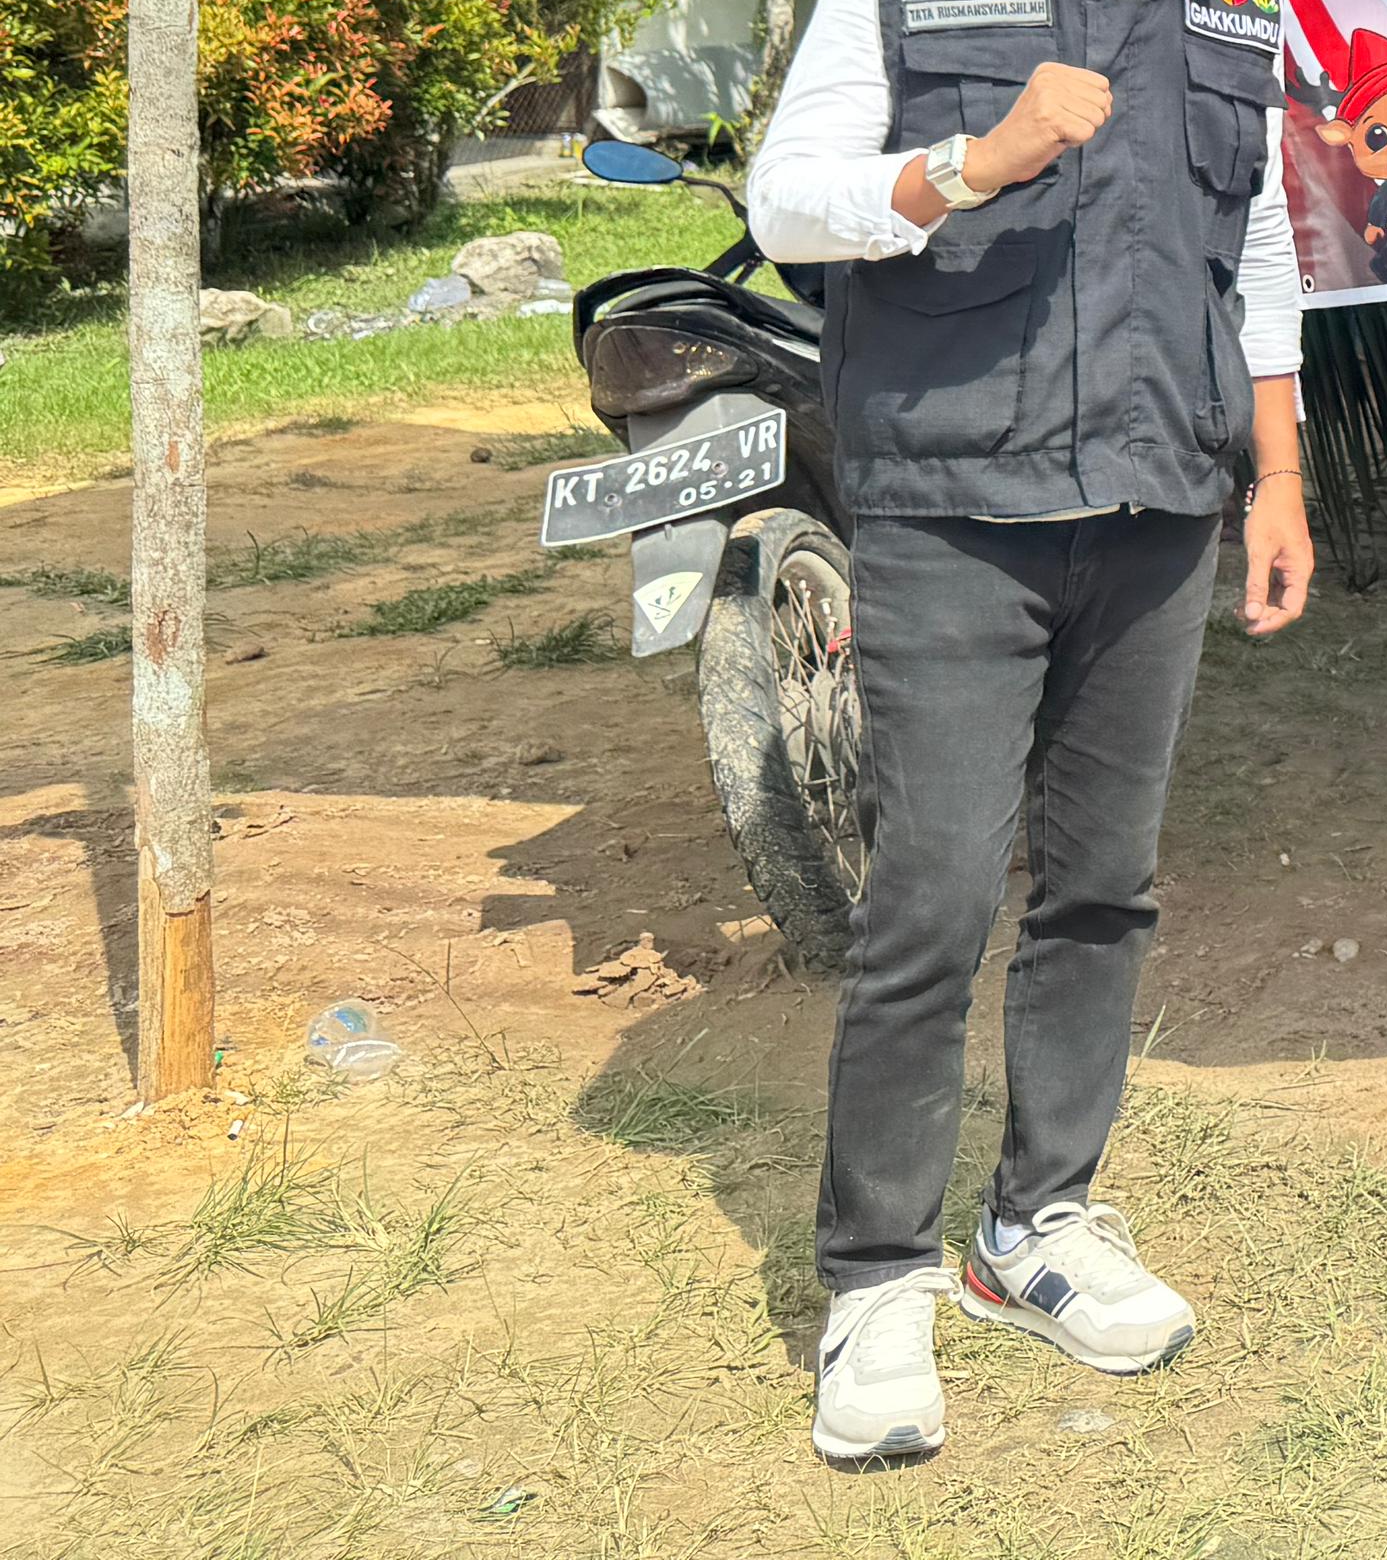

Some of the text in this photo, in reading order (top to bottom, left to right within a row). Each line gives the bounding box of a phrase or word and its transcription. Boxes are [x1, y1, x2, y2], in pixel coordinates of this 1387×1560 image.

[1190, 2, 1279, 43] GAKKUMDU
[554, 420, 778, 508] KT 2624 VR
